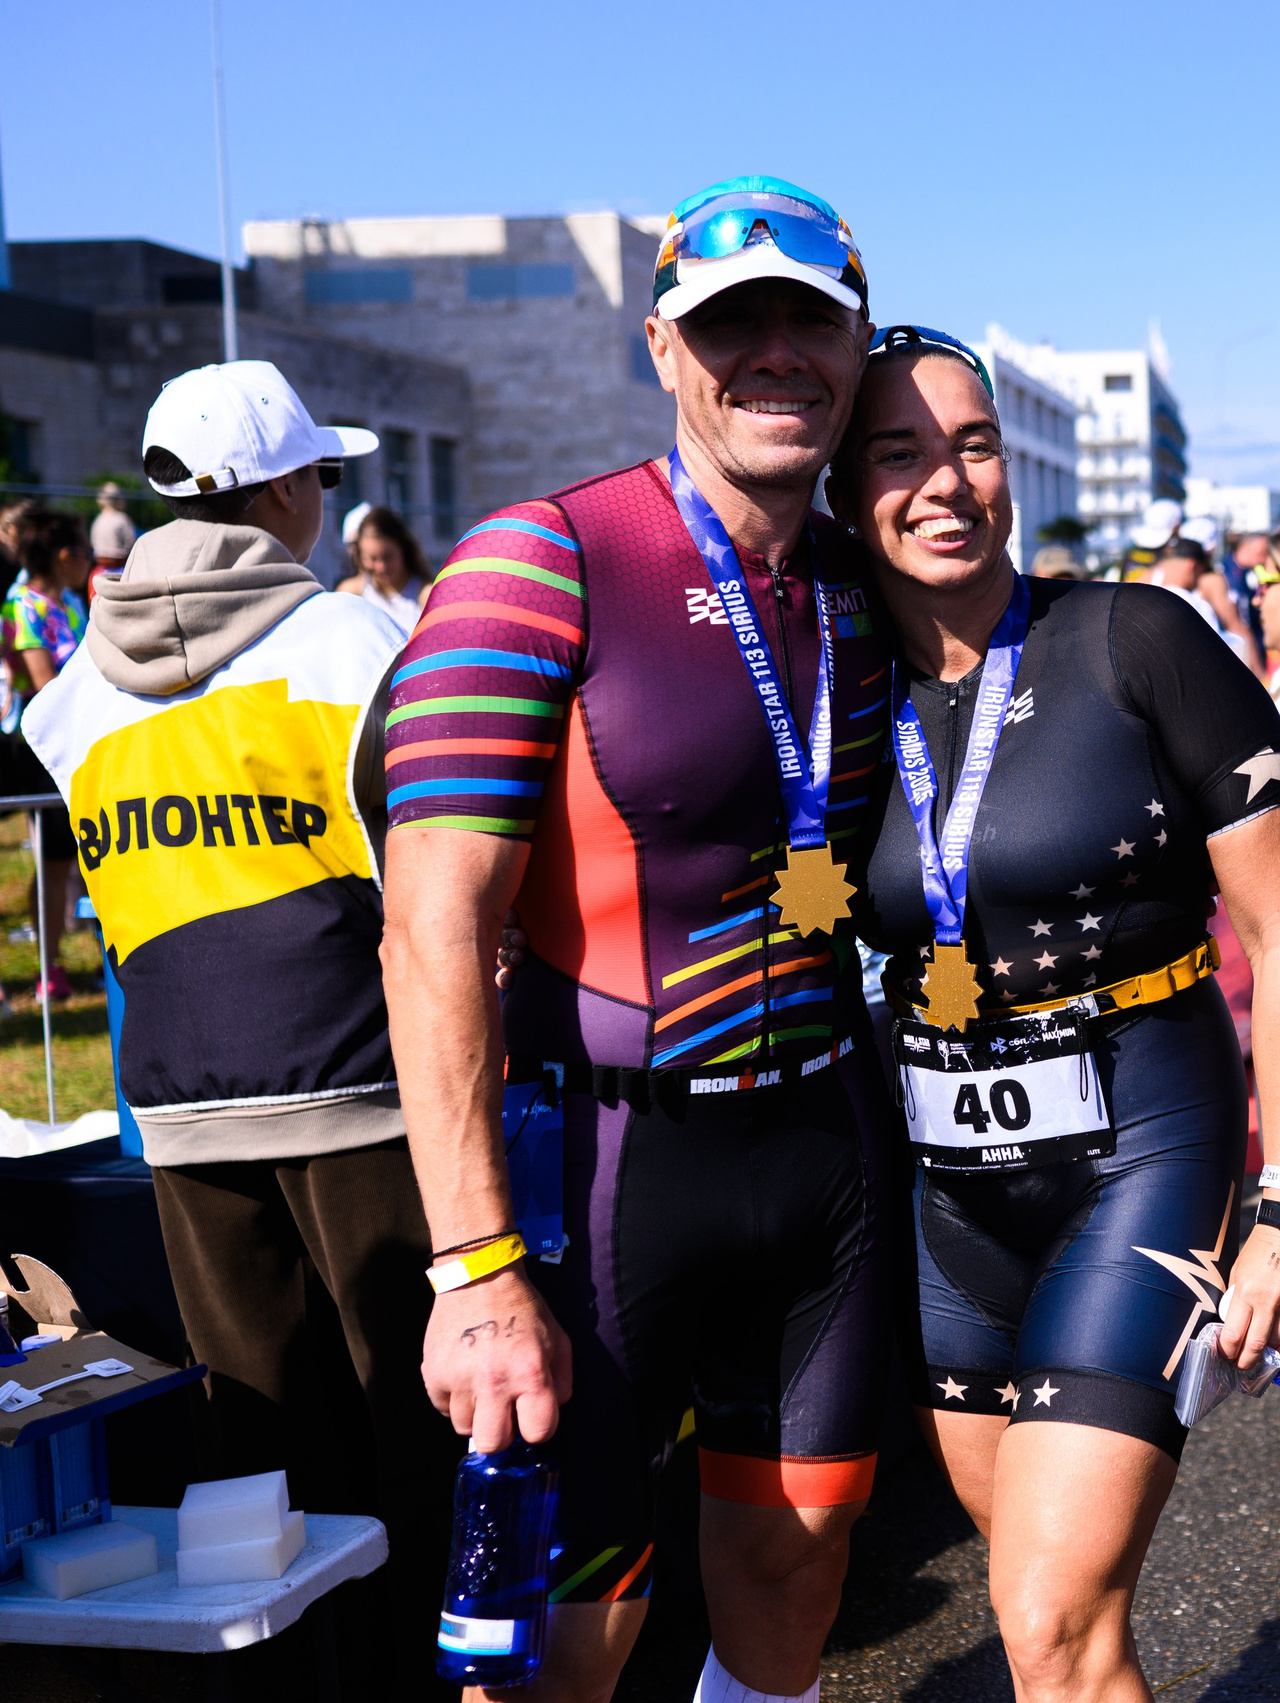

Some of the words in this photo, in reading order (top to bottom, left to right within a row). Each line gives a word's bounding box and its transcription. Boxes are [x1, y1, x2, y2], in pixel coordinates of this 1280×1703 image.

[718, 579, 760, 645] SIRIUS
[816, 587, 867, 615] ЕМП
[746, 648, 771, 680] 113
[758, 681, 802, 780] IRONSTAR
[896, 720, 926, 769] SIRIUS
[965, 684, 1007, 773] IRONSTAR
[907, 766, 934, 807] 2025
[957, 773, 983, 803] 113
[942, 804, 973, 870] SIRIUS
[801, 1036, 854, 1077] IRONMAN
[690, 1067, 781, 1095] IRONMAN
[953, 1078, 1032, 1134] 40
[981, 1146, 1023, 1163] АННА
